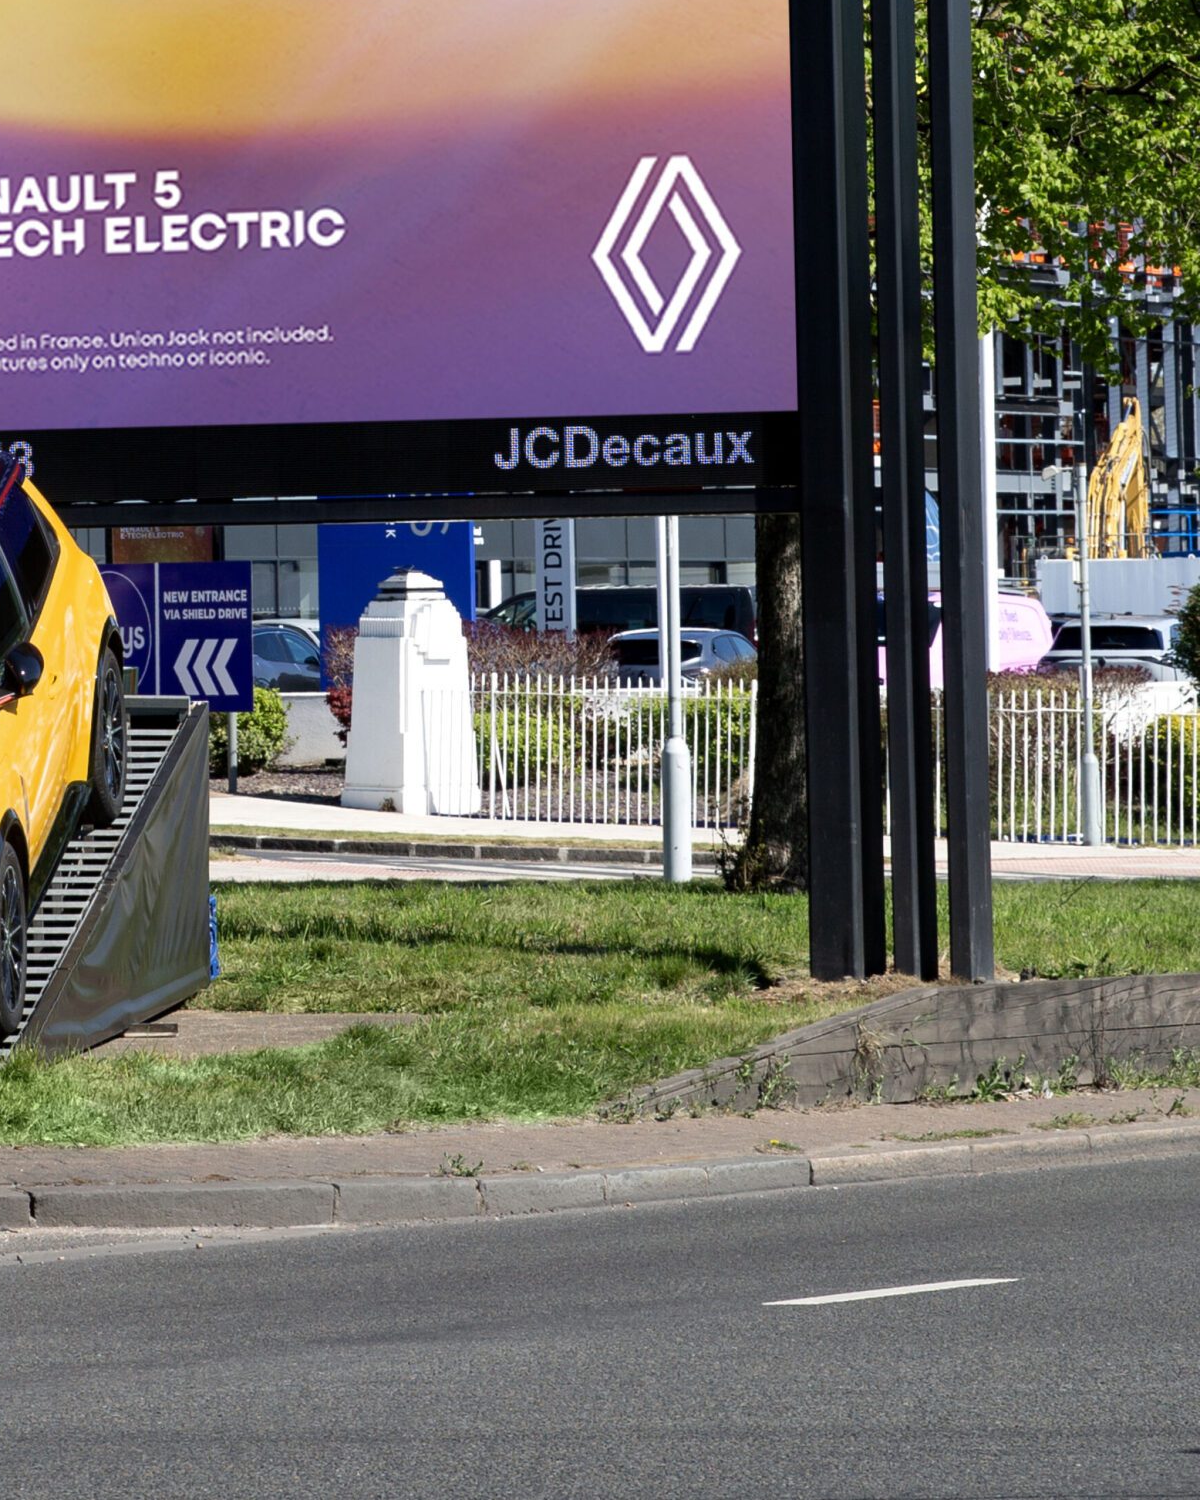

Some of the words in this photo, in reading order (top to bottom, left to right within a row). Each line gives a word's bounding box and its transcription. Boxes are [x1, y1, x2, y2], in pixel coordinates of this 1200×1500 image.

[155, 171, 180, 208] 5
[105, 209, 344, 253] ELECTRIC
[20, 334, 37, 350] in
[40, 333, 109, 349] France.
[110, 330, 164, 348] Union
[167, 329, 210, 346] Jack
[212, 330, 245, 344] not
[246, 326, 334, 344] included.
[50, 354, 89, 373] only
[92, 355, 116, 369] on
[118, 351, 185, 369] techno
[187, 351, 206, 367] or
[209, 348, 271, 365] iconic.
[494, 425, 755, 470] JCDecaux
[163, 591, 189, 603] NEW
[191, 589, 248, 602] ENTRANCE
[163, 609, 180, 620] VIA
[182, 609, 215, 620] SHIELD
[218, 608, 248, 619] DRIVE
